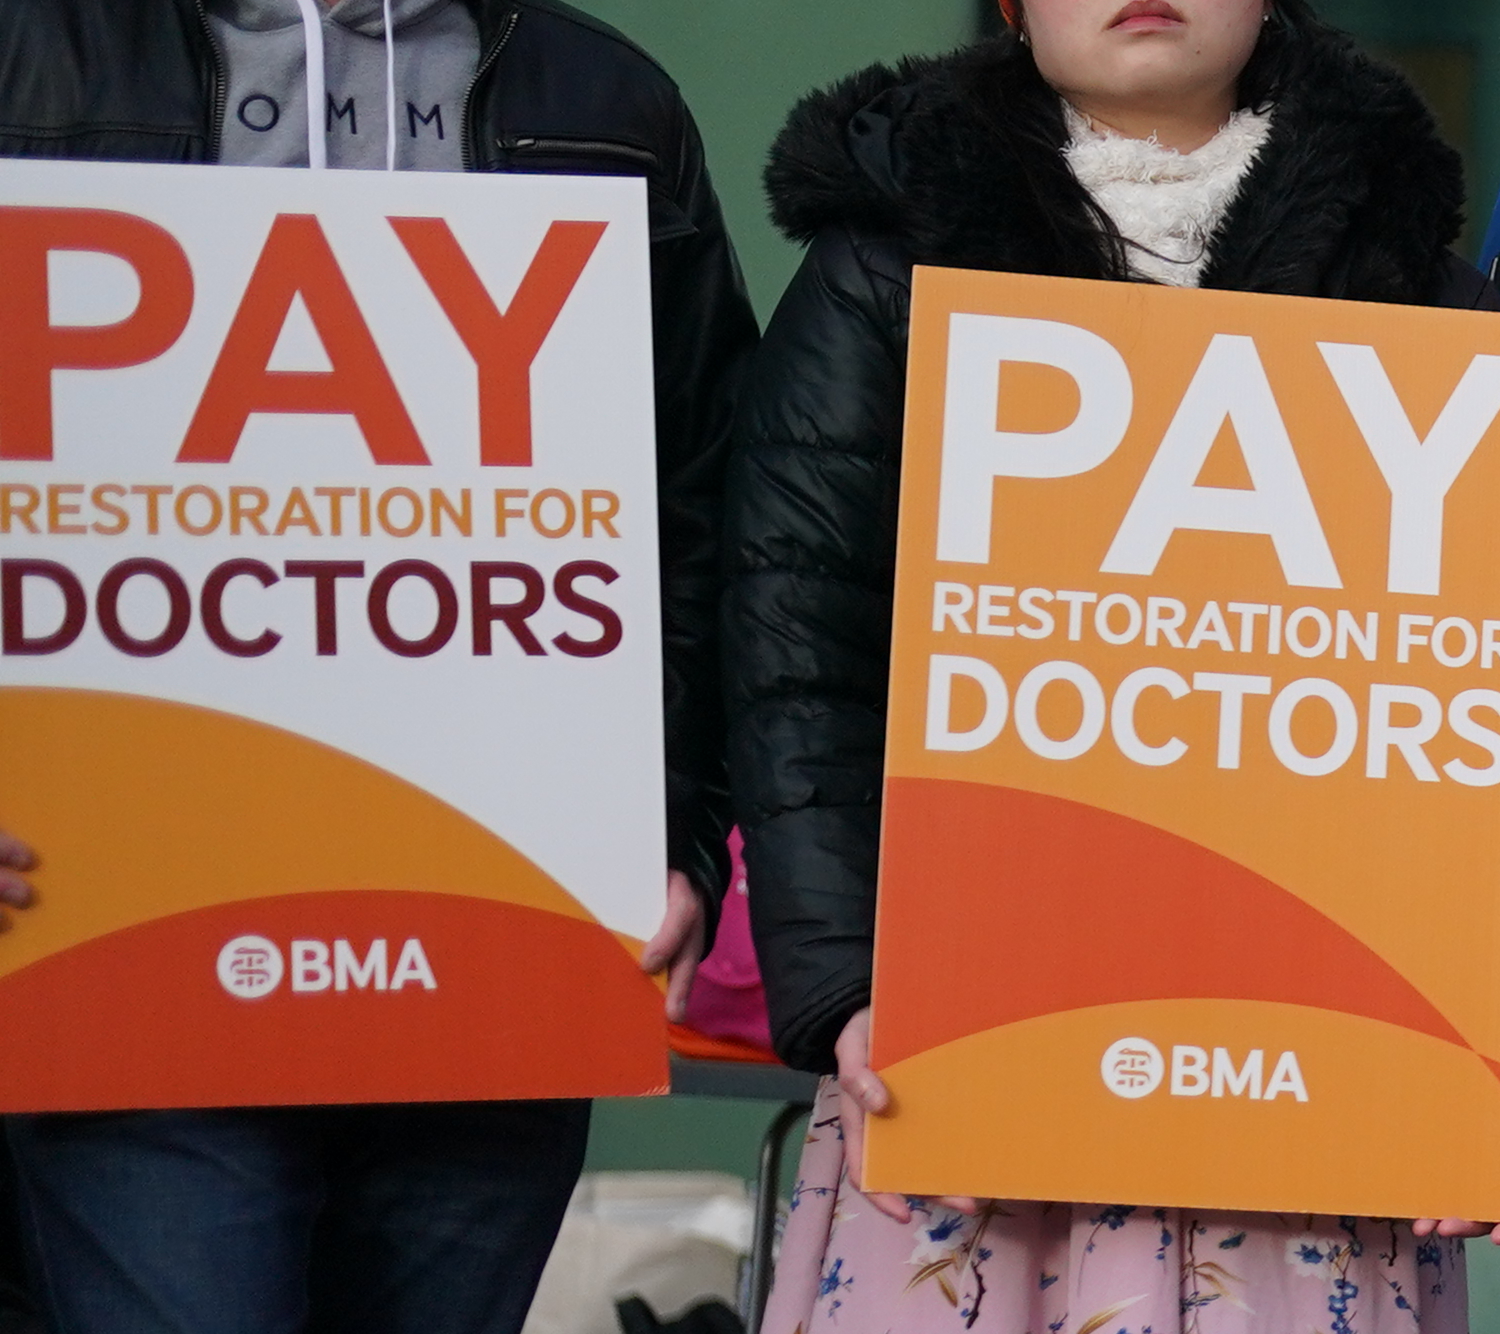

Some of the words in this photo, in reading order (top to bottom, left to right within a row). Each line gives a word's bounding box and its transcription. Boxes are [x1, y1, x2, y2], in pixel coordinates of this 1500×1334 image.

[0, 206, 609, 467] PAY
[0, 483, 474, 538] RESTORATION
[495, 488, 621, 539] FOR
[3, 557, 624, 658] DOCTORS
[932, 580, 1377, 661] RESTORATION
[291, 937, 438, 993] BMA
[1171, 1044, 1309, 1102] BMA
